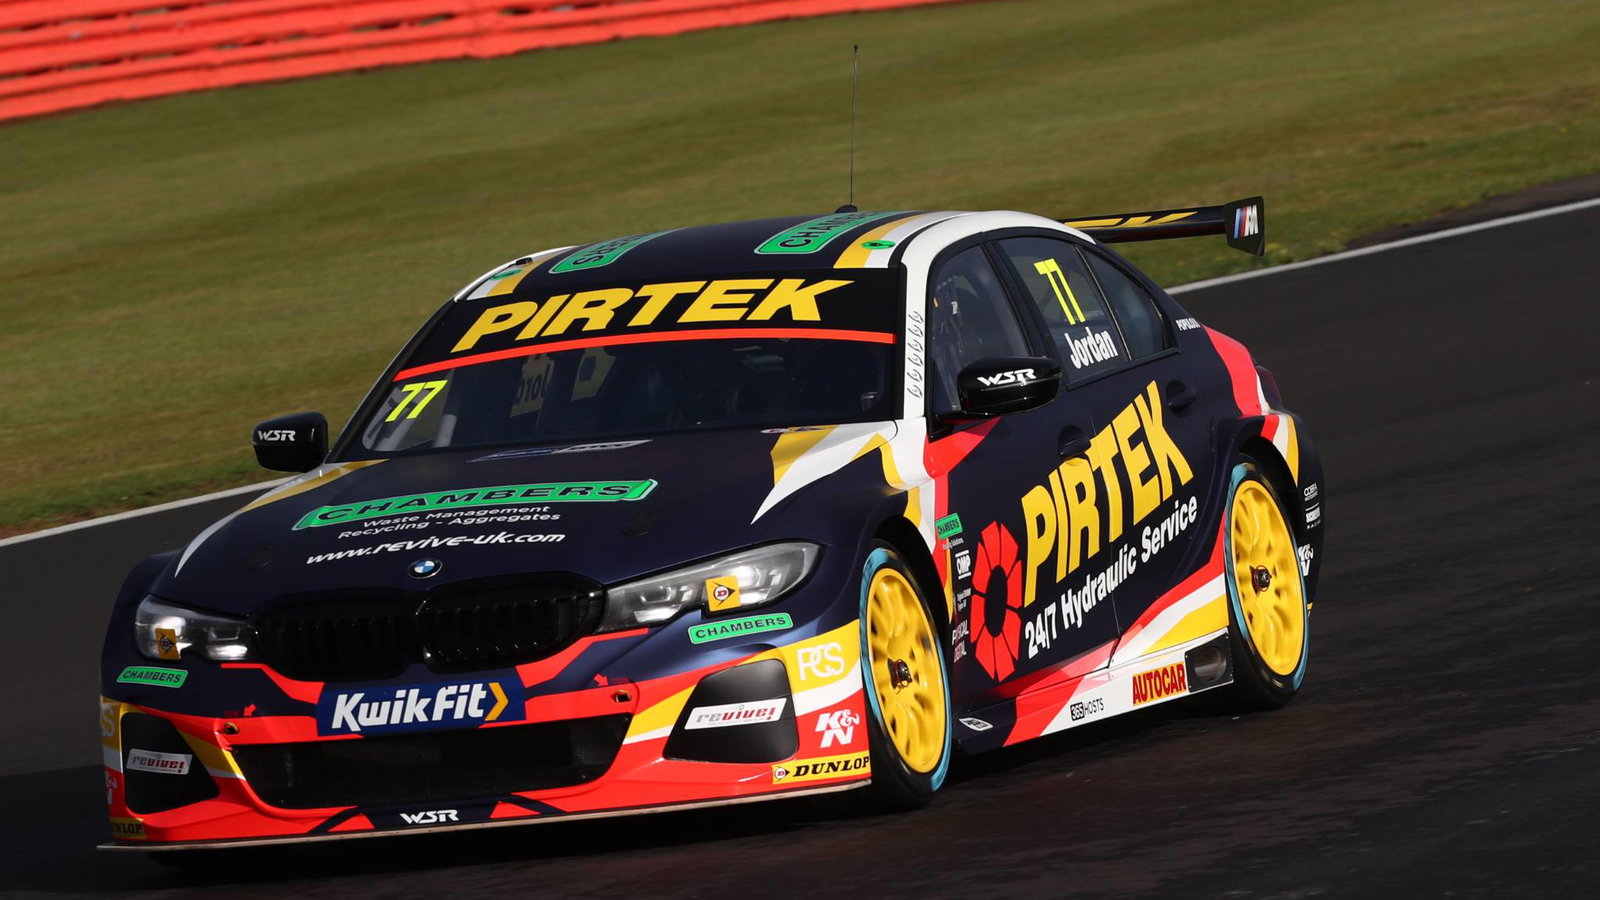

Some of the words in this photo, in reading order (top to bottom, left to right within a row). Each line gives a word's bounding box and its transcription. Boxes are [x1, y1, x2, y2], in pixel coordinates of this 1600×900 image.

[1034, 257, 1087, 325] 77
[450, 278, 856, 353] PIRTEK
[1067, 326, 1119, 369] Jordan
[976, 368, 1037, 387] WSR
[385, 380, 448, 422] 77
[257, 430, 296, 443] WSR
[316, 483, 635, 523] CHAMBERS
[1021, 380, 1194, 609] PIRTEK
[338, 521, 429, 540] Recycling
[447, 513, 561, 527] Aggregates
[363, 515, 420, 529] Waste
[425, 506, 551, 521] Management
[306, 532, 567, 564] www.revive-uk.com
[957, 554, 971, 575] OMP
[1024, 611, 1059, 660] 24/7
[1060, 546, 1138, 630] Hydraulic
[1141, 496, 1198, 564] Service
[695, 614, 788, 640] CHAMBERS
[122, 668, 184, 685] CHAMBERS
[1132, 663, 1187, 705] AUTOCAR
[792, 756, 870, 777] DUNLOP
[112, 822, 143, 834] NLOP
[400, 809, 460, 824] WSR
